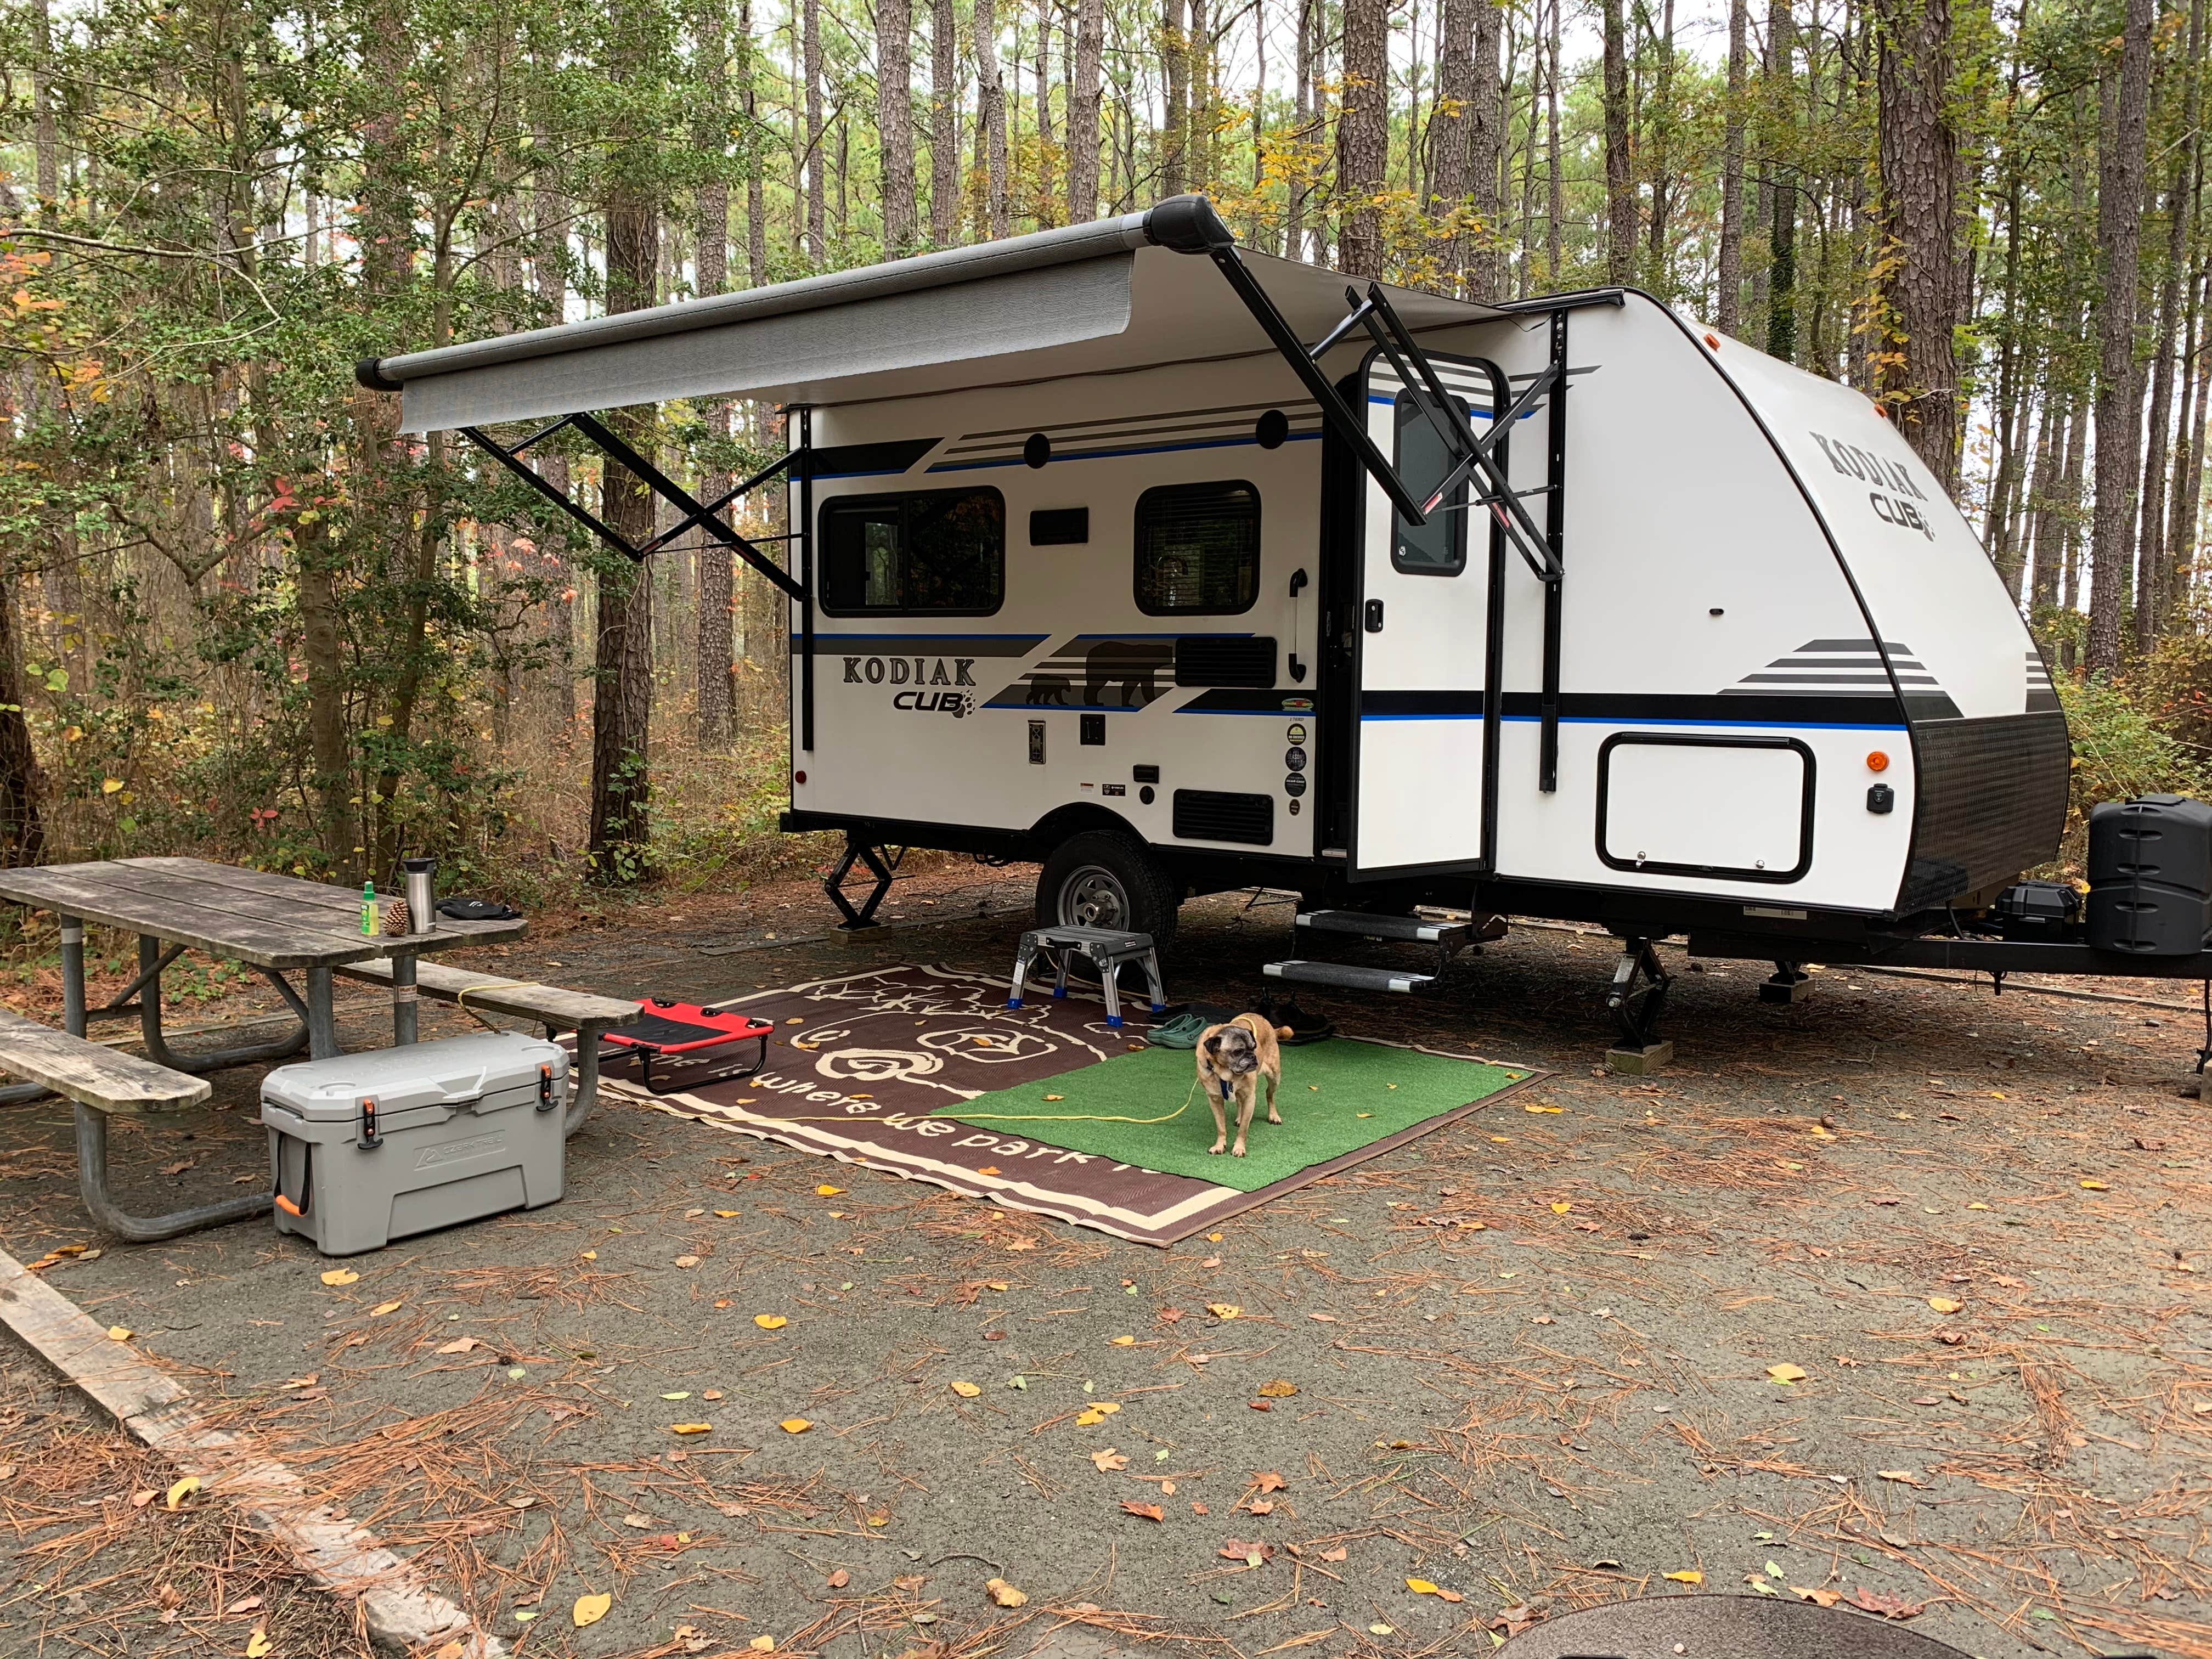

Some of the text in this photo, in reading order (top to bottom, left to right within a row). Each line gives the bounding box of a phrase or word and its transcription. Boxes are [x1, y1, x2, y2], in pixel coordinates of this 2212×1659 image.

[1809, 431, 1928, 502] KODIAK
[1870, 493, 1924, 531] CUB
[843, 657, 977, 686] KODIAK
[893, 691, 964, 712] CUB
[753, 1071, 882, 1114] where
[883, 1112, 956, 1137] we
[951, 1134, 1098, 1164] park
